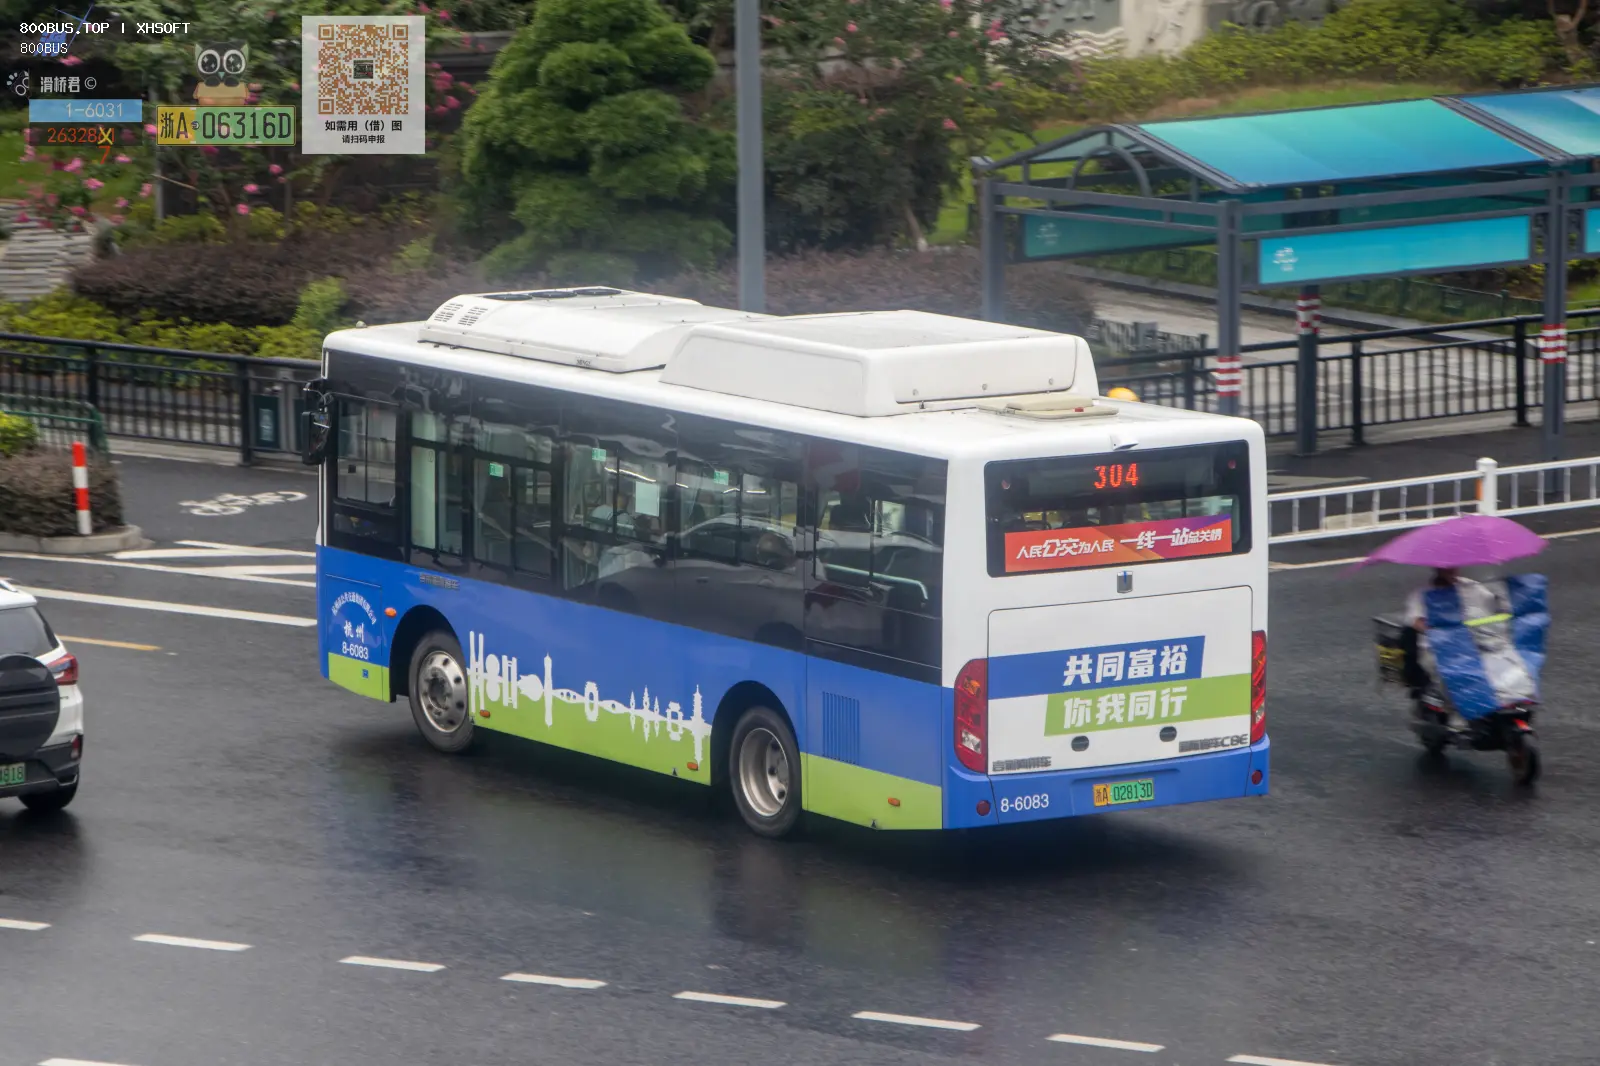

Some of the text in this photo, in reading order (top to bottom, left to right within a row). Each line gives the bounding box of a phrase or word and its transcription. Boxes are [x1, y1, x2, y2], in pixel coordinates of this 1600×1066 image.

[1094, 463, 1139, 489] 304
[341, 641, 369, 660] 8-6083
[1063, 644, 1188, 687] 共同富裕
[1063, 686, 1188, 729] 你我同行
[1000, 794, 1050, 812] 8-6083
